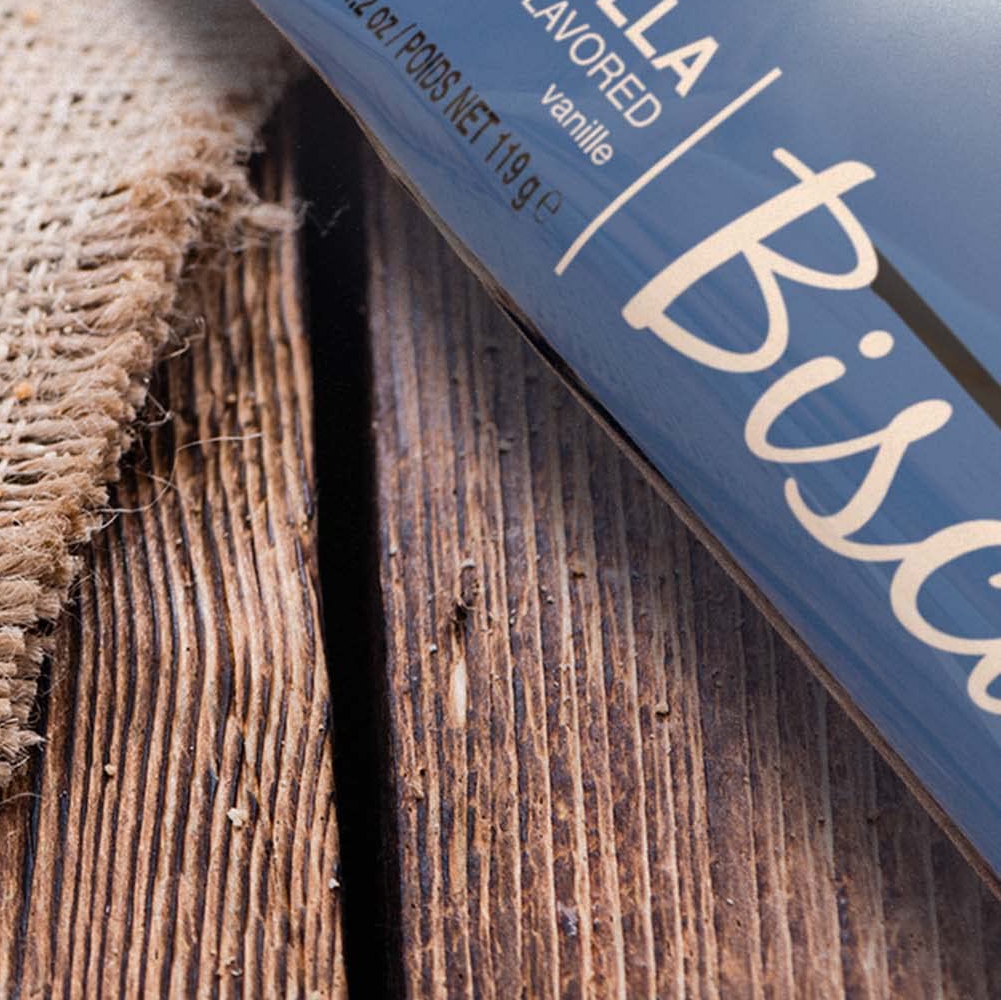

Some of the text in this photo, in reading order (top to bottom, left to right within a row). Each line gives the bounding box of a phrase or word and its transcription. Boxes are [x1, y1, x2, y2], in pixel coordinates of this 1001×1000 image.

[366, 6, 399, 40] oz
[383, 22, 418, 47] /
[394, 30, 462, 103] POIDS
[443, 85, 502, 144] NET
[540, 83, 614, 166] vanille
[484, 133, 532, 185] 119
[510, 176, 541, 212] g
[621, 147, 1001, 715] Bisc
